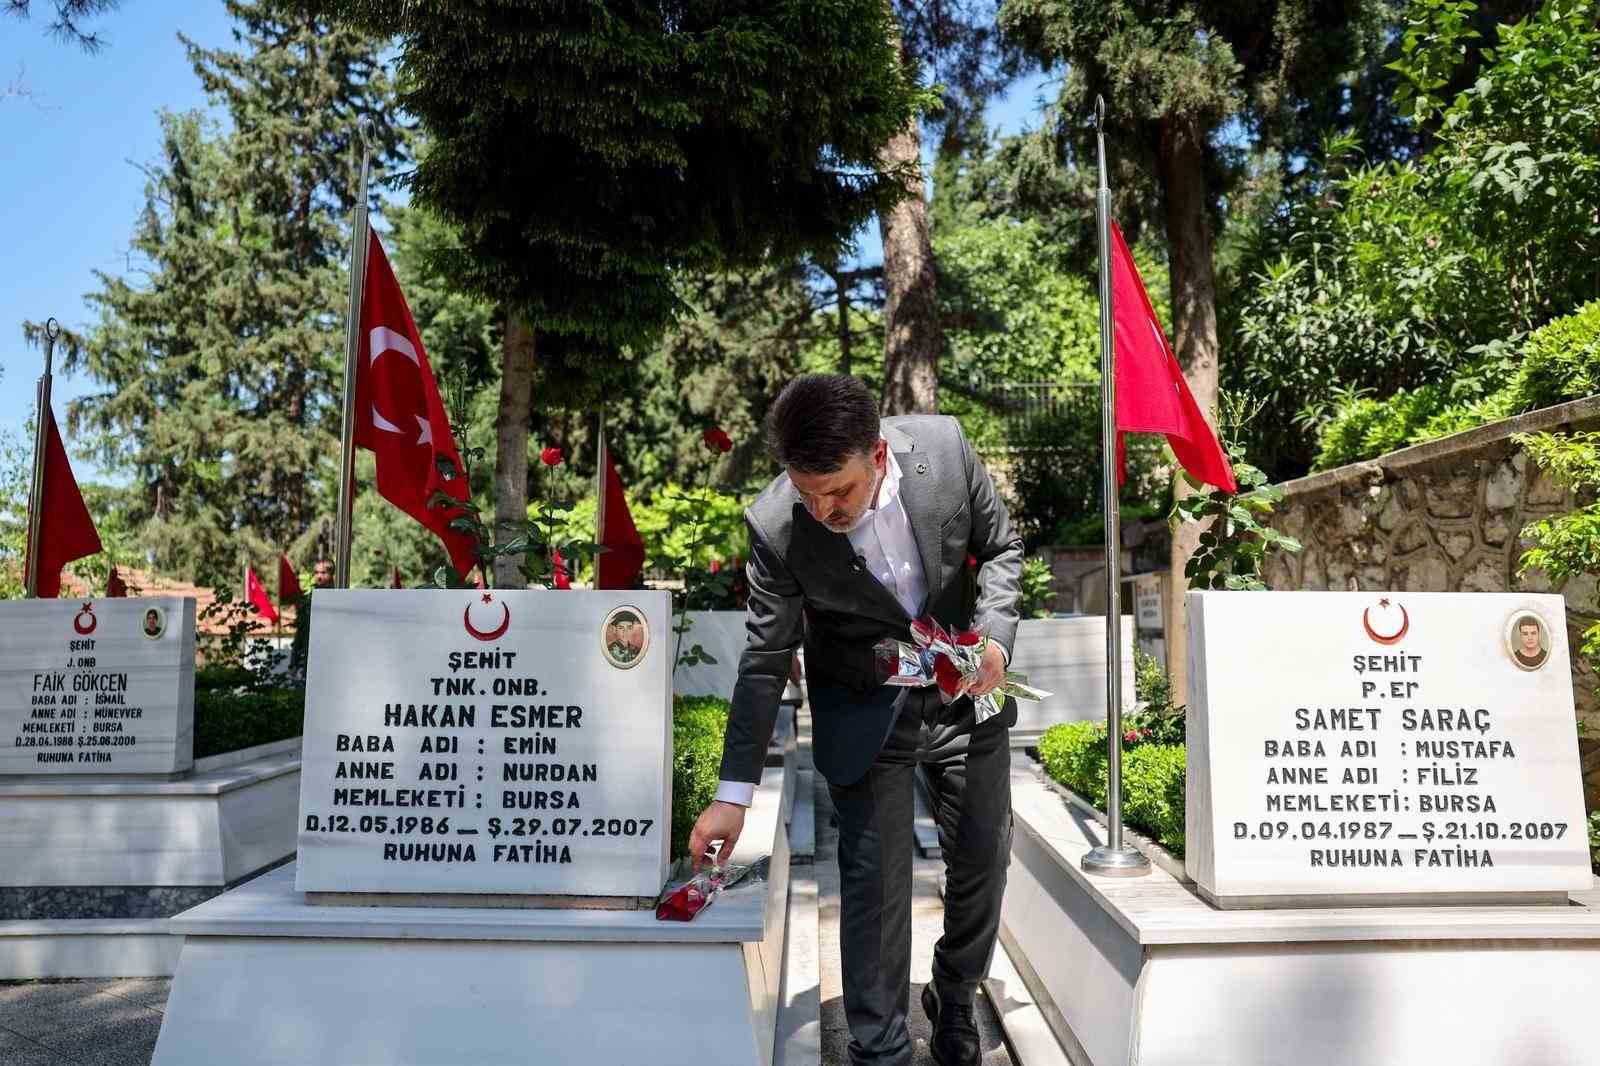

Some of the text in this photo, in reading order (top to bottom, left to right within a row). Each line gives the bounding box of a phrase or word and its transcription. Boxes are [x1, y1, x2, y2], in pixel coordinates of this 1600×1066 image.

[70, 639, 96, 652] ŞEHİT
[448, 646, 516, 673] ŞEHİT
[1353, 650, 1422, 674] ŞEHİT
[34, 672, 64, 691] FAİK
[32, 696, 56, 704] BABA
[61, 696, 77, 704] ADI
[95, 693, 125, 704] İSMAİL
[32, 709, 56, 718] ANNE
[60, 709, 76, 718] ADI
[95, 708, 142, 718] MÜNEVVER
[384, 704, 583, 729] HAKAN ESMER
[1295, 708, 1490, 735] SAMET SARAÇ
[23, 722, 75, 732] MEMLEKETİ
[93, 723, 123, 732] BURSA
[336, 735, 395, 753] BABA
[420, 736, 458, 754] ADI
[503, 732, 556, 755] EMİN
[1264, 740, 1326, 758] BABA
[1340, 741, 1377, 758] ADI
[37, 751, 111, 762] RUHUNA FATİHA
[335, 762, 394, 780] ANNE
[419, 763, 458, 781] ADI
[503, 764, 597, 782] NURDAN
[1266, 767, 1328, 785] ANNE
[1342, 767, 1378, 785] ADI
[502, 791, 579, 809] BURSA
[1419, 795, 1497, 813] BURSA
[384, 840, 572, 863] RUHUNA FATİHA
[1310, 844, 1494, 867] RUHUNA FATİHA
